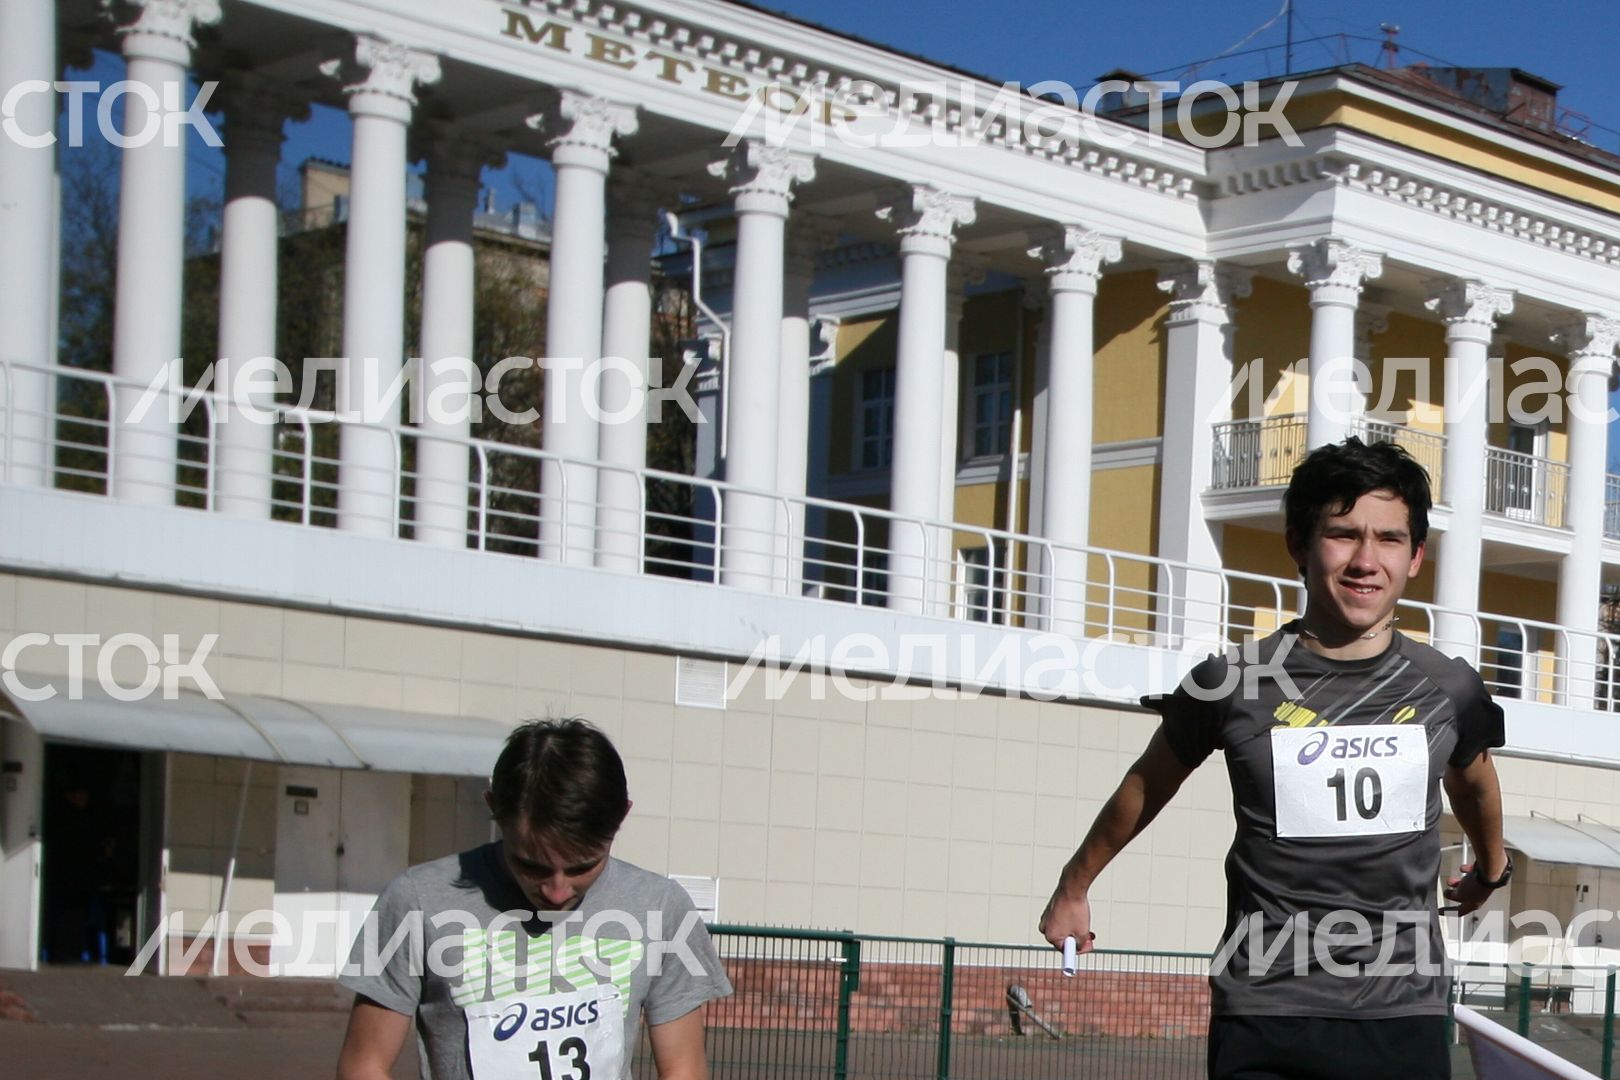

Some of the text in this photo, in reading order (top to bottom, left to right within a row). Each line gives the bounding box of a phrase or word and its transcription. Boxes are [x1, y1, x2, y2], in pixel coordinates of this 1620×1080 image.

[501, 8, 859, 127] МЕТЕОР
[1326, 767, 1382, 822] 10
[450, 927, 643, 1019] JUST
[530, 1000, 599, 1032] asics
